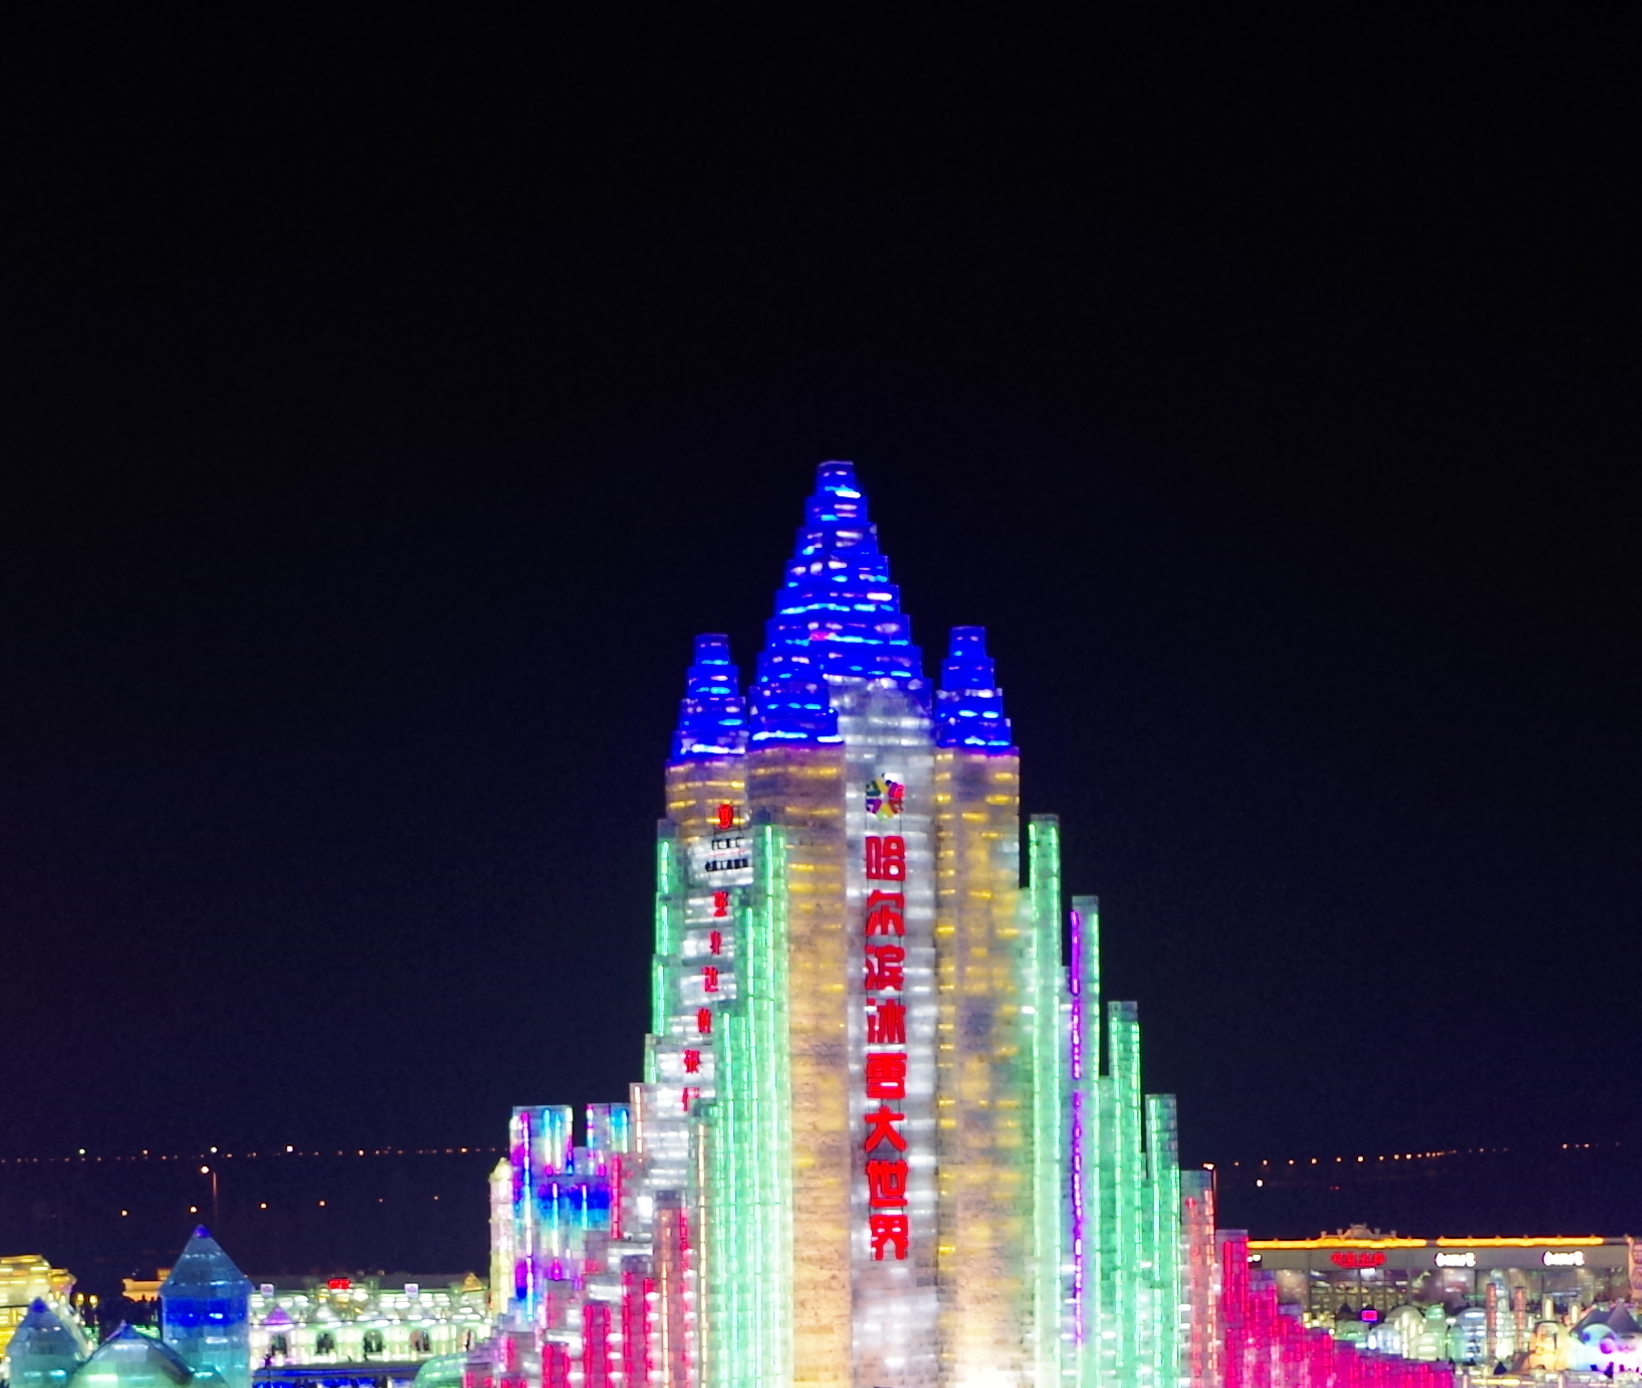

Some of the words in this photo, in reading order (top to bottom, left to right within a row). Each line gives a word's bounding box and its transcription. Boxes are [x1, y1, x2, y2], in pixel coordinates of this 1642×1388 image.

[864, 836, 909, 1261] 哈尔滨冰雪大世界
